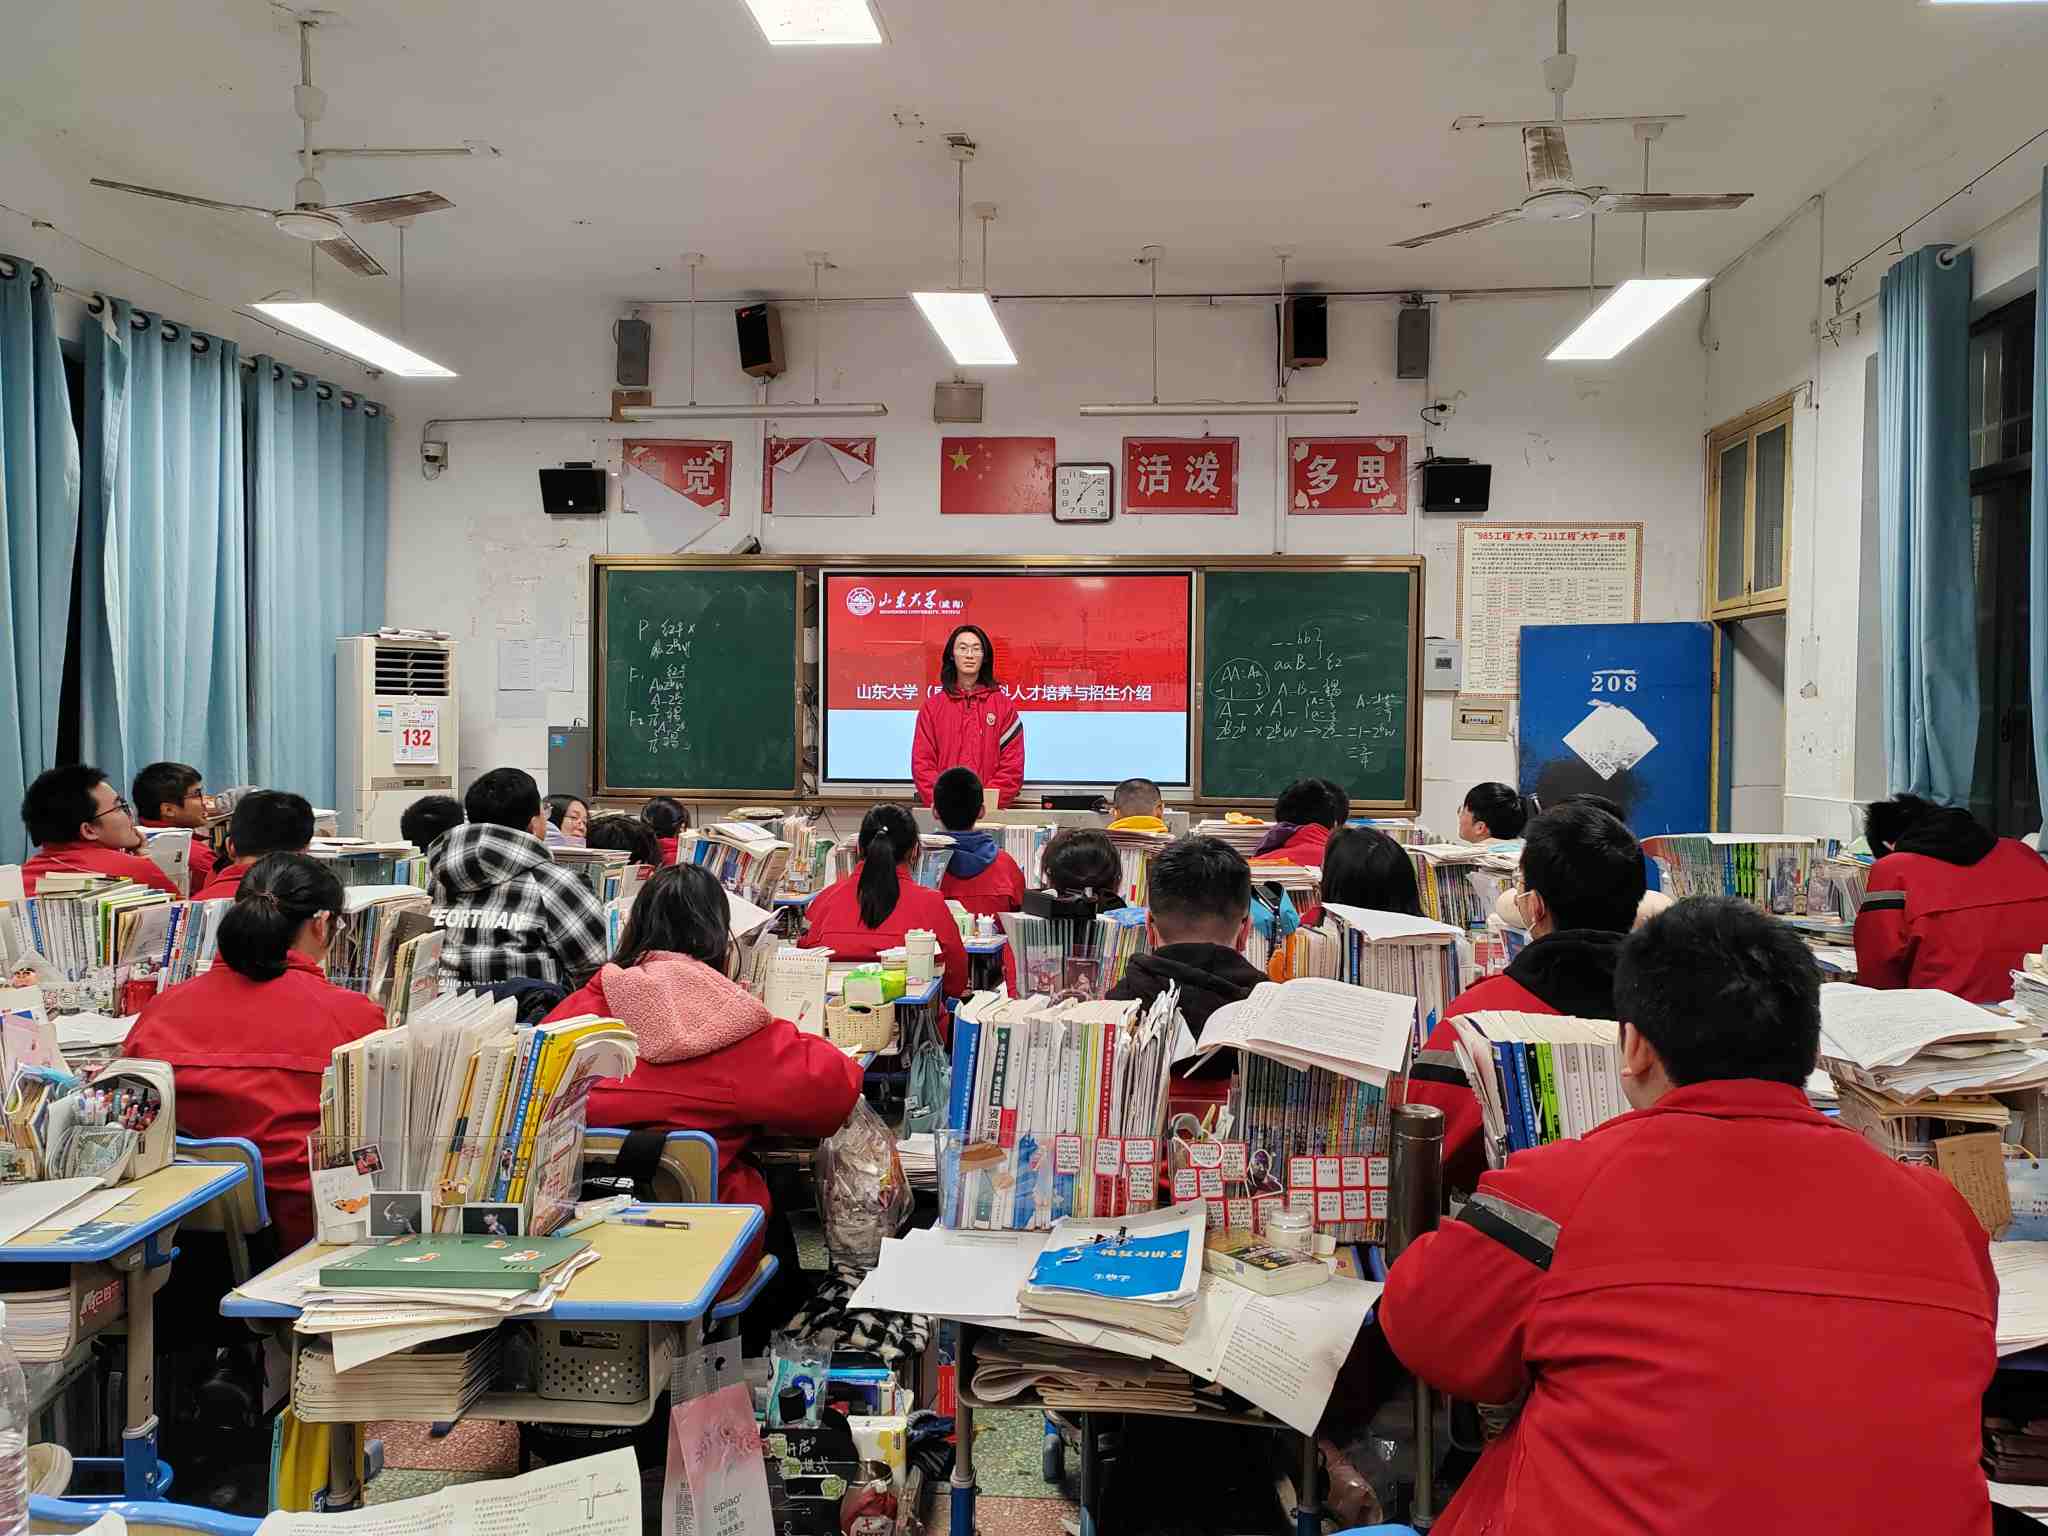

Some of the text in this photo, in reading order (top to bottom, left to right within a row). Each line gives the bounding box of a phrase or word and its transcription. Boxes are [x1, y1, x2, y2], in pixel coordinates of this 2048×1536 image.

[1137, 451, 1220, 497] 活泼
[1307, 455, 1390, 495] 多思
[1591, 676, 1637, 692] 208
[402, 728, 432, 747] 132
